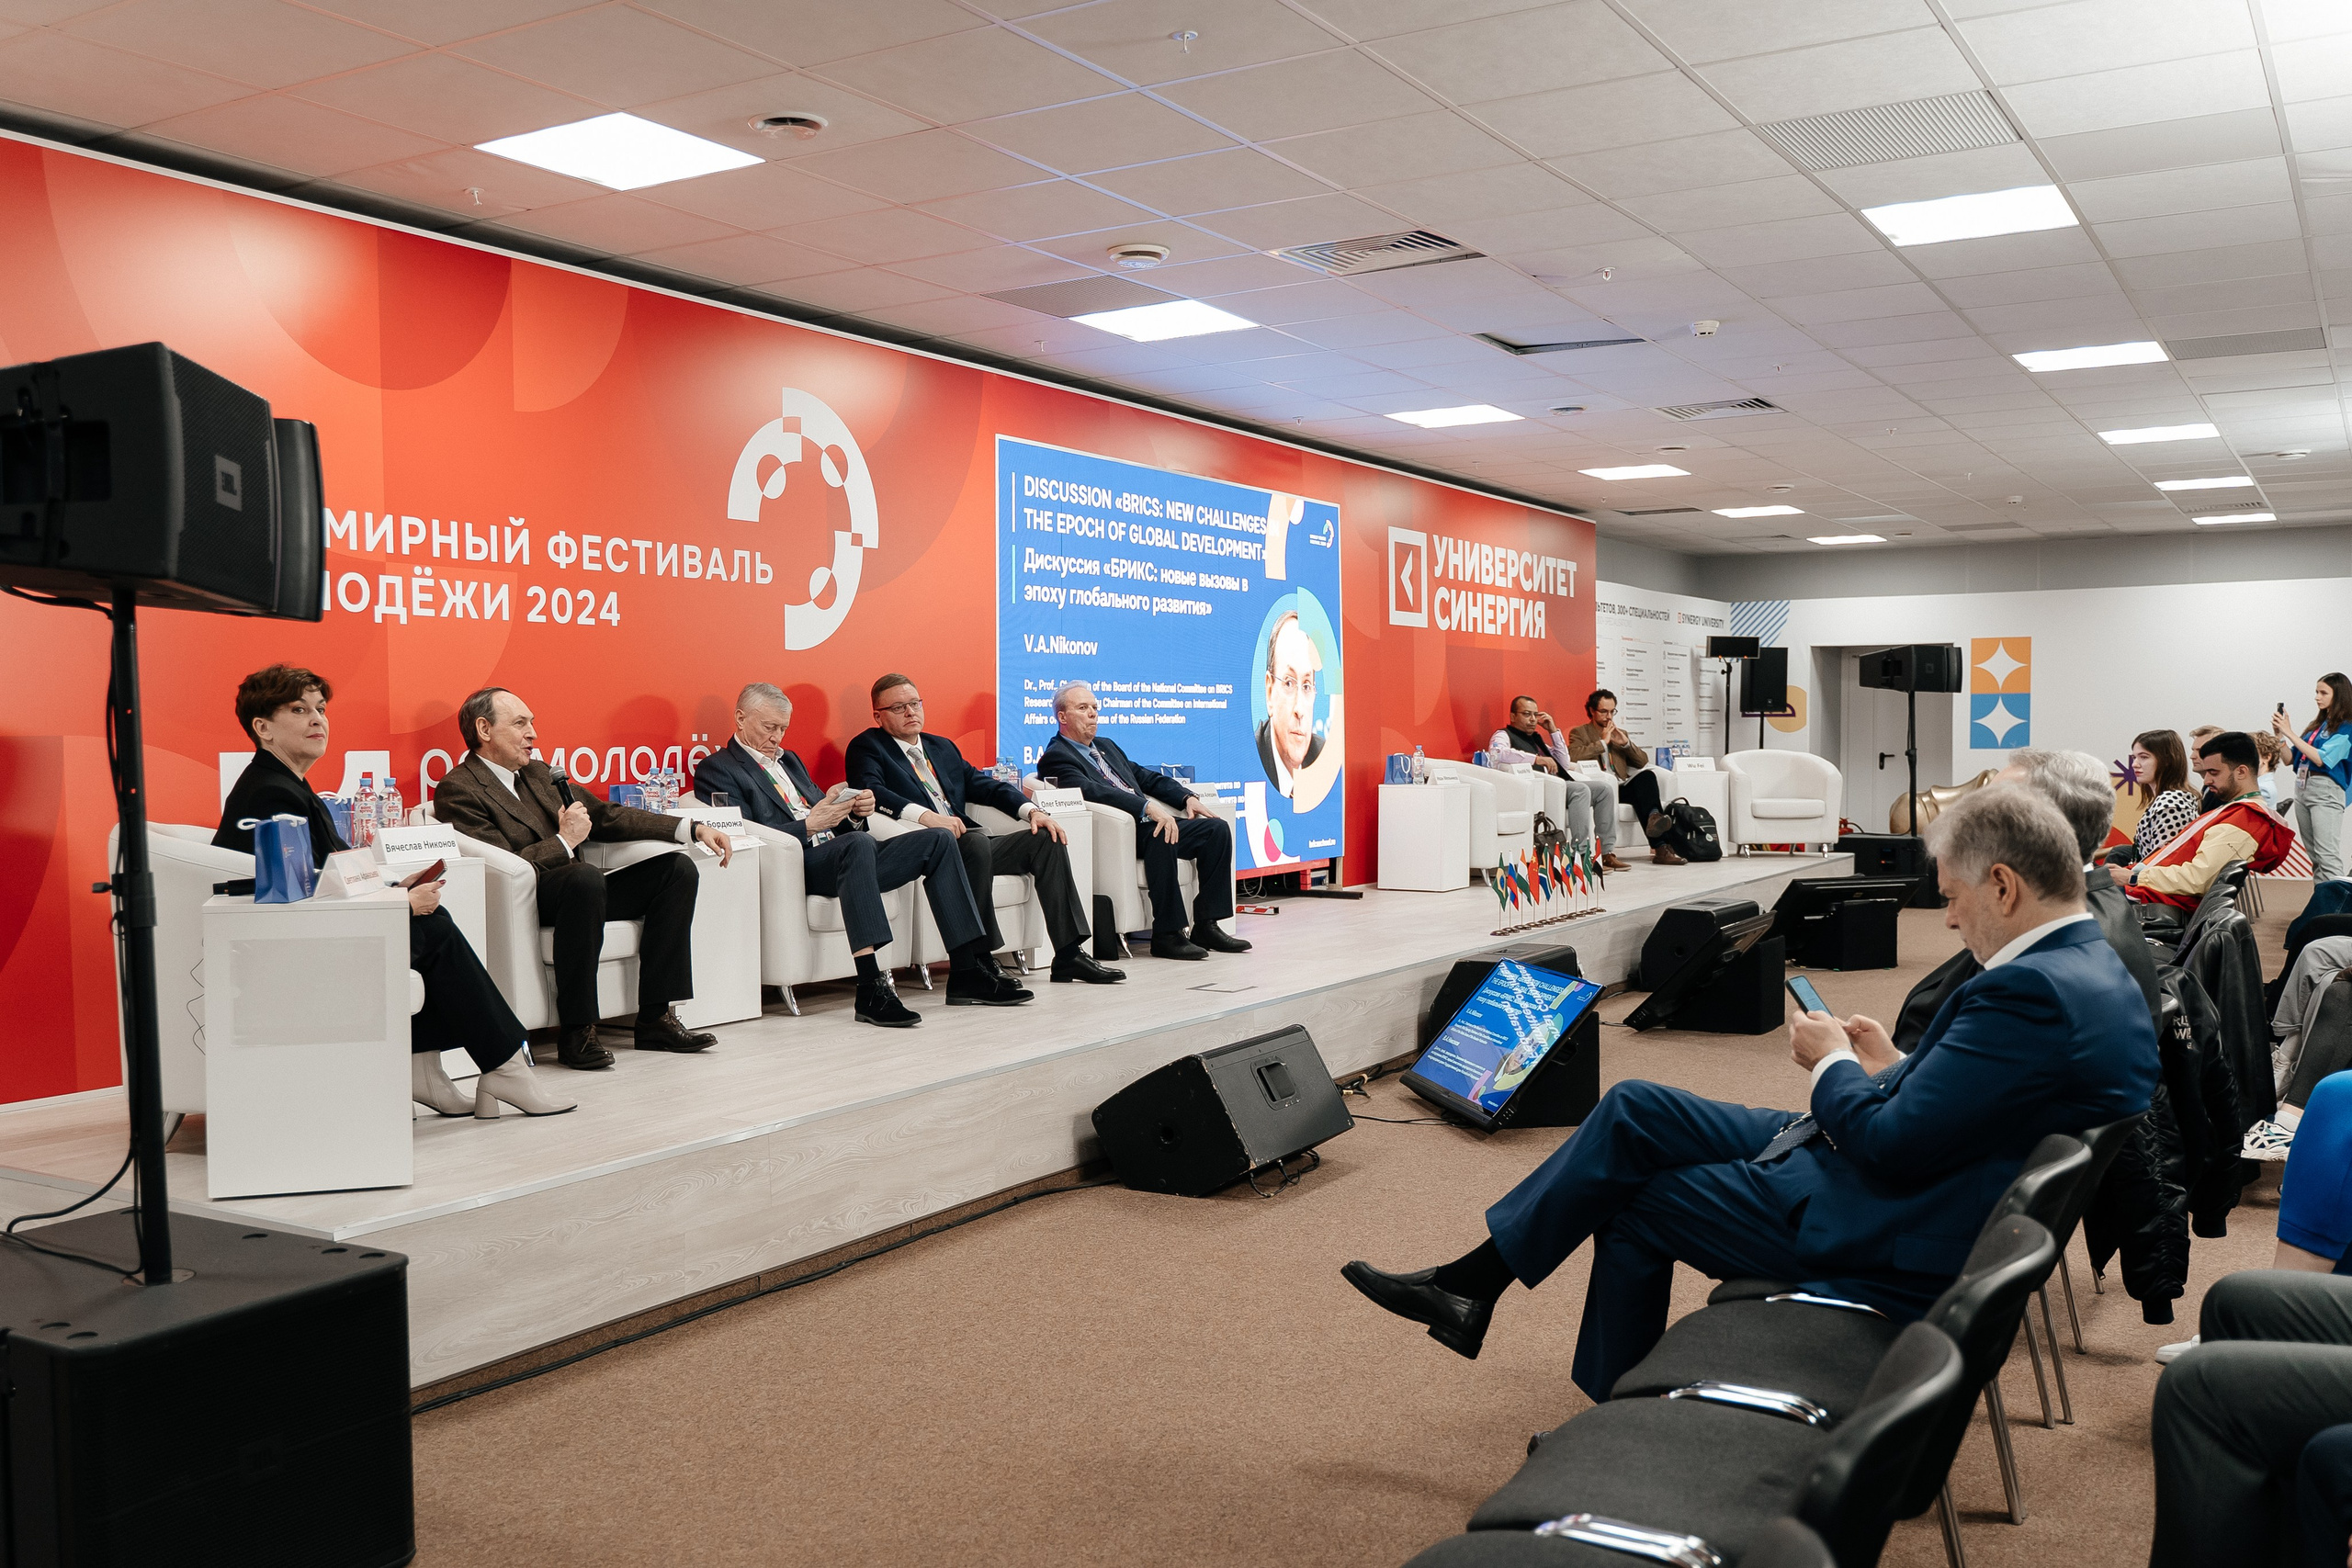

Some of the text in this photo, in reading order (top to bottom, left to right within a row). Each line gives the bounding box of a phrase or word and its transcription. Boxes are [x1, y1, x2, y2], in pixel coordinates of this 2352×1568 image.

[1023, 475, 1112, 510] DISCUSSION
[1115, 493, 1163, 518] «BRICS:
[1166, 500, 1193, 524] NEW
[1196, 506, 1267, 536] CHALLENGES
[1023, 508, 1054, 533] THE
[1057, 513, 1104, 539] EPOCH
[1108, 519, 1126, 542] OF
[1129, 525, 1179, 550] GLOBAL
[323, 507, 774, 585] МИРНЫЙ ФЕСТИВАЛЬ
[1023, 547, 1101, 577] Дискуссия
[1103, 557, 1158, 582] «БРИКС:
[1160, 567, 1197, 587] новые
[1199, 571, 1239, 592] вызовы
[1432, 534, 1577, 598] УНИВЕРСИТЕТ
[526, 586, 621, 626] 2024
[1023, 585, 1213, 616] эпоху глобального развития»
[1434, 586, 1545, 639] СИНЕРГИЯ
[1629, 606, 1670, 622] СПЕЦИАЛЬНОСТЕЙ
[1682, 613, 1724, 628] SYNERGY UNIVERSITY
[1023, 634, 1099, 656] V.A.Nikonov
[1101, 681, 1112, 692] the
[1113, 682, 1130, 693] Board
[1138, 682, 1150, 693] the
[1152, 682, 1176, 694] National
[1177, 683, 1206, 694] Committee
[1207, 685, 1215, 694] on
[1102, 697, 1133, 708] Chairman
[1141, 698, 1152, 708] the
[1153, 698, 1184, 709] Committee
[1184, 701, 1193, 709] on
[1023, 714, 1048, 725] Affairs
[1118, 714, 1129, 724] the
[1130, 714, 1153, 725] Russian
[1155, 714, 1186, 724] Federation
[1055, 800, 1083, 808] Евтушенко
[707, 820, 743, 829] Бордюжа
[385, 840, 457, 852] Вячеслав Никонов
